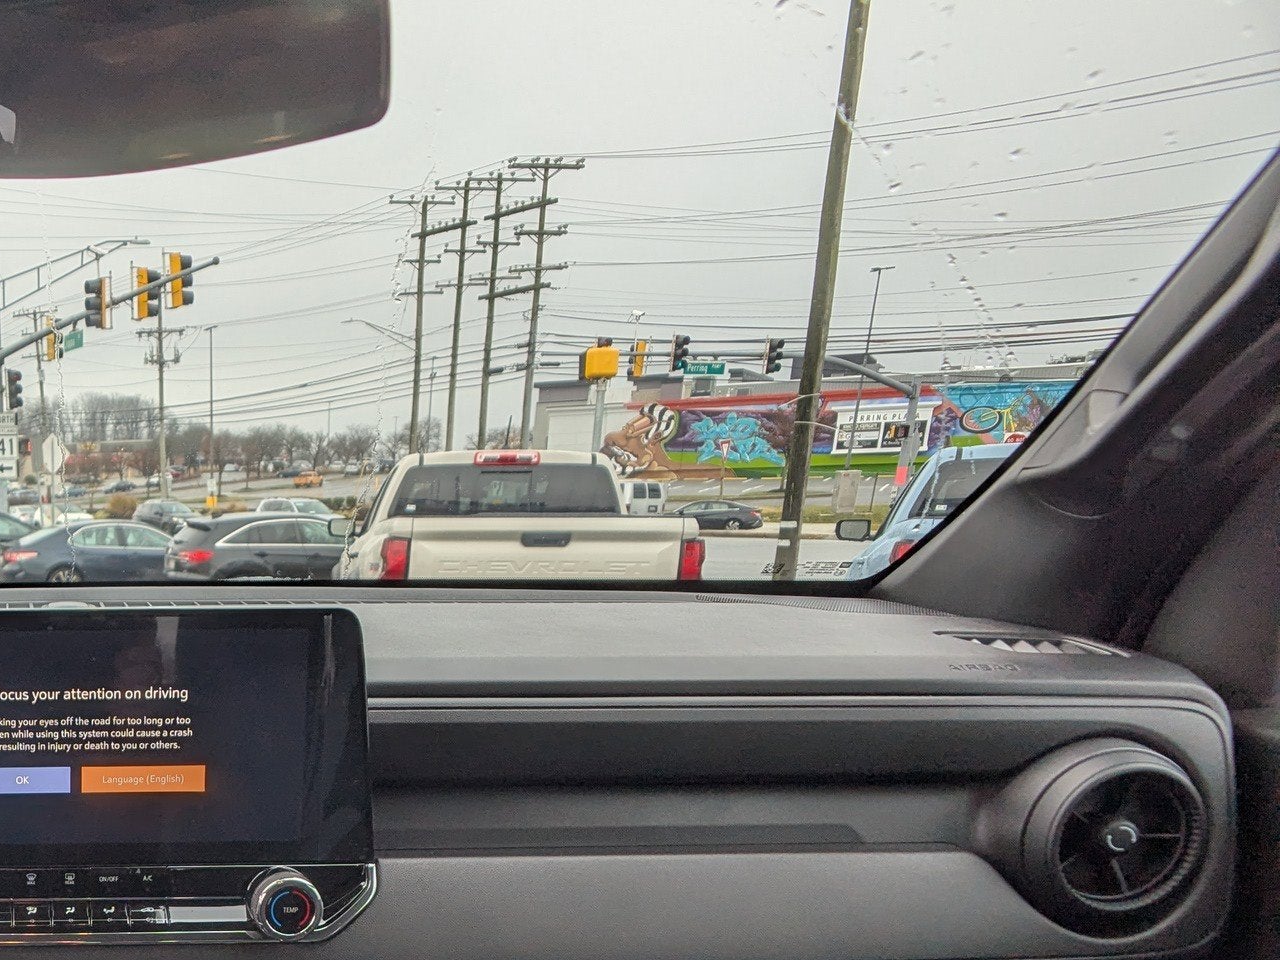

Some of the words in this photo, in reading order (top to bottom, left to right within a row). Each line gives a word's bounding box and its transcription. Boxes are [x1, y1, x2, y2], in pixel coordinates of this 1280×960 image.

[687, 364, 708, 374] Perring
[437, 560, 651, 575] CHEVROLET
[948, 664, 1020, 672] AIRBAG
[32, 690, 60, 704] your
[63, 688, 121, 700] attention
[124, 690, 141, 700] on
[144, 686, 188, 702] driving
[18, 718, 37, 728] your
[39, 718, 58, 728] eyes
[60, 716, 74, 726] off
[75, 717, 89, 725] the
[91, 717, 110, 725] road
[112, 716, 125, 725] for
[143, 716, 163, 726] long
[176, 716, 191, 724] too
[12, 730, 34, 738] while
[36, 730, 59, 740] using
[61, 729, 76, 738] this
[79, 730, 108, 740] system
[110, 728, 134, 737] could
[170, 728, 193, 737] crash
[48, 742, 71, 752] injury
[84, 741, 109, 750] death
[122, 742, 137, 751] you
[150, 740, 180, 749] others.
[16, 776, 29, 784] OK
[102, 776, 144, 785] Language
[146, 774, 184, 785] (English)
